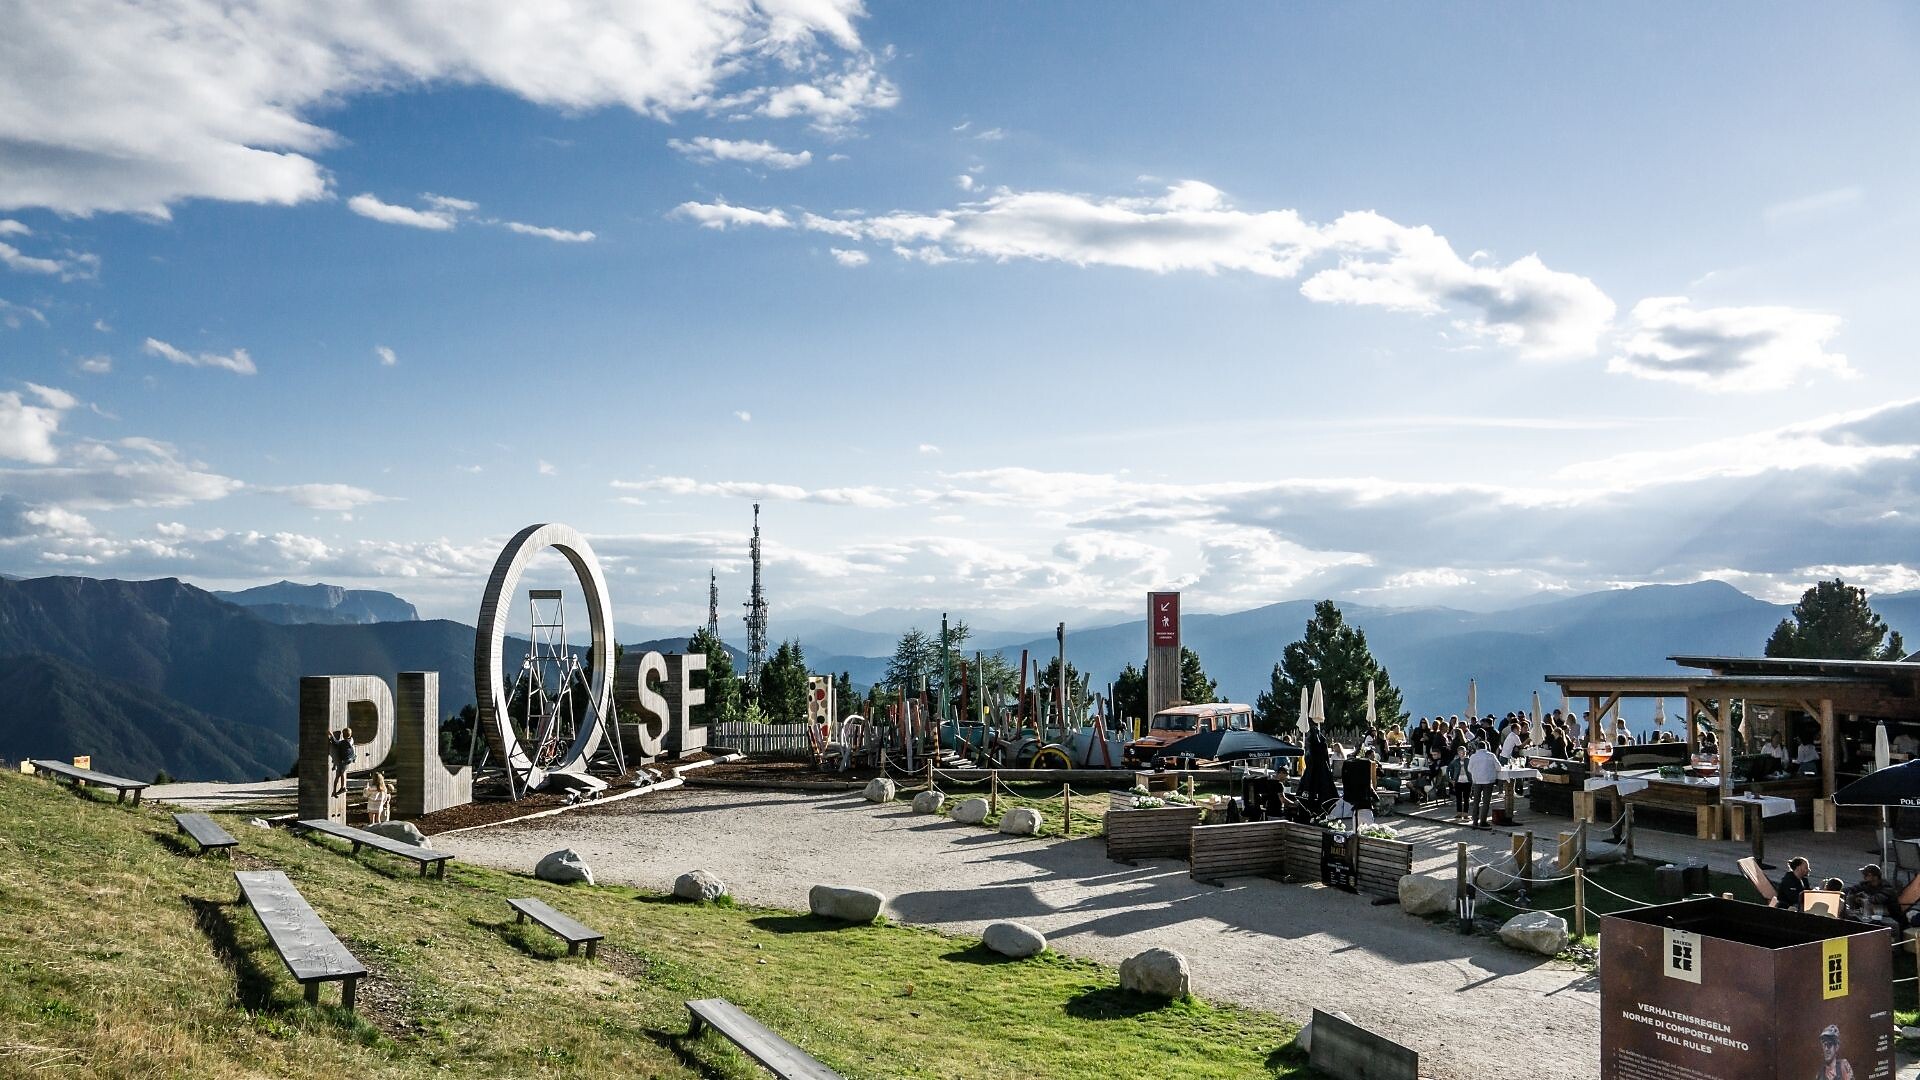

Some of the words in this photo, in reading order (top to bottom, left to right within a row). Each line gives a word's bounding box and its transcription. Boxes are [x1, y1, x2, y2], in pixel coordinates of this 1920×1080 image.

[299, 523, 708, 825] PLOSE
[1622, 1010, 1654, 1026] NORME
[1654, 1019, 1664, 1028] DI
[1665, 1022, 1749, 1051] COMPORTAMENTO
[1637, 1002, 1731, 1034] VERHALTENSREGELN
[1655, 1031, 1682, 1046] TRAIL
[1682, 1039, 1712, 1054] RULES
